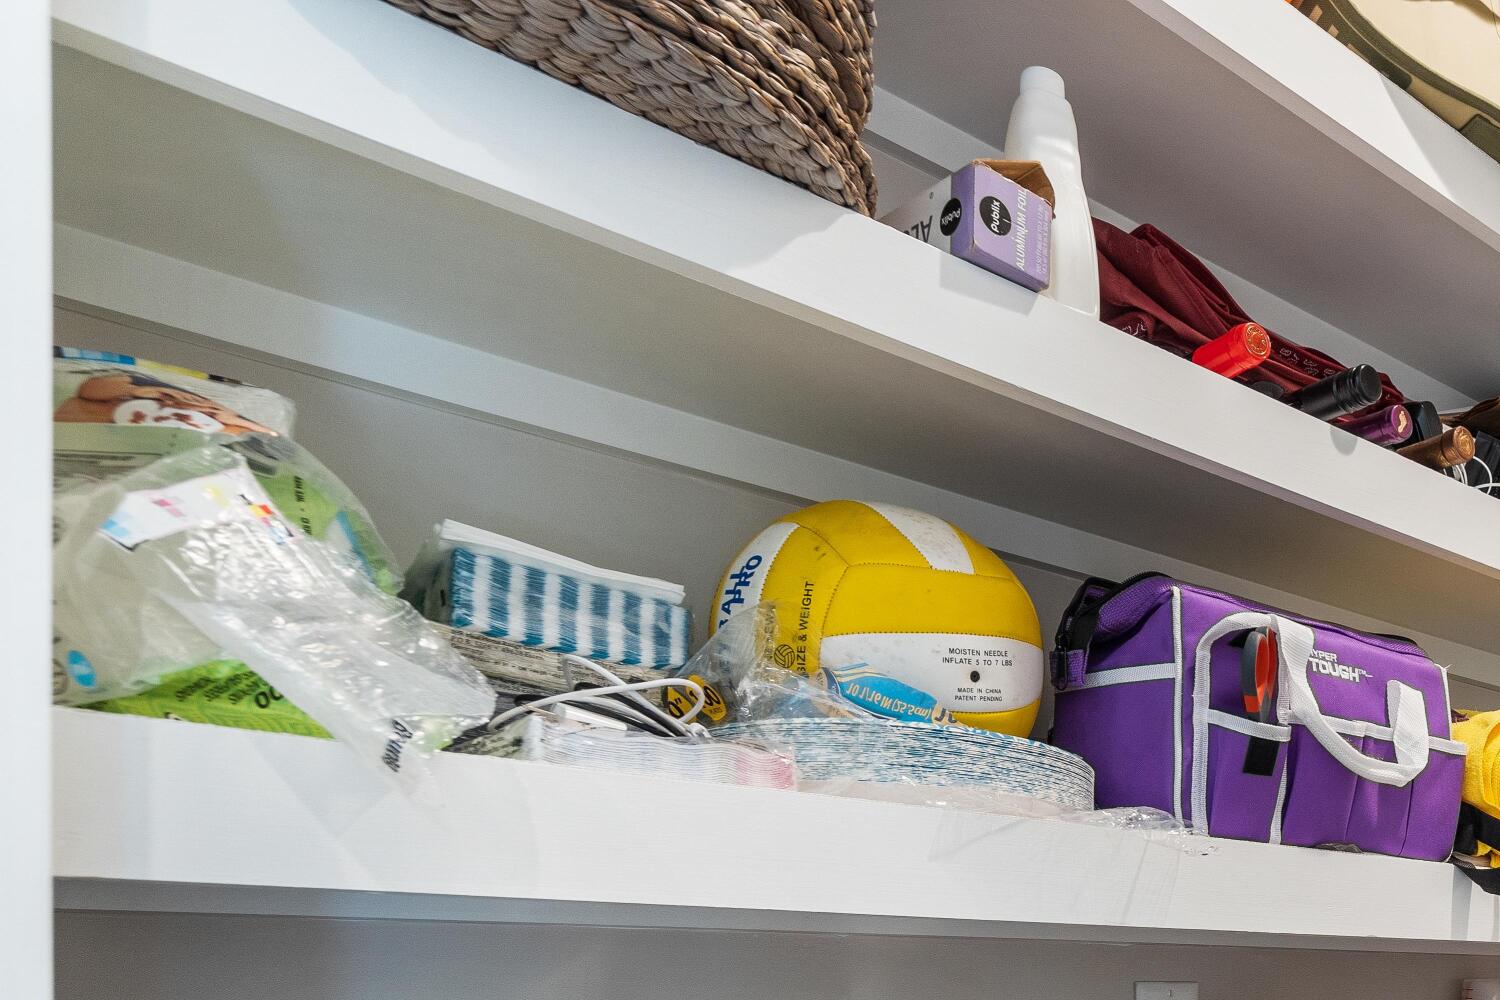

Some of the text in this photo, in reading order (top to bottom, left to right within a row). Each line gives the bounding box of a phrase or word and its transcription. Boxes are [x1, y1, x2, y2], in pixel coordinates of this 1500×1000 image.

[1016, 215, 1026, 270] ALUMINUM
[799, 581, 815, 631] WEIGHT
[942, 657, 972, 665] INFLATE
[948, 647, 1008, 657] MOISTEN NEEDLE
